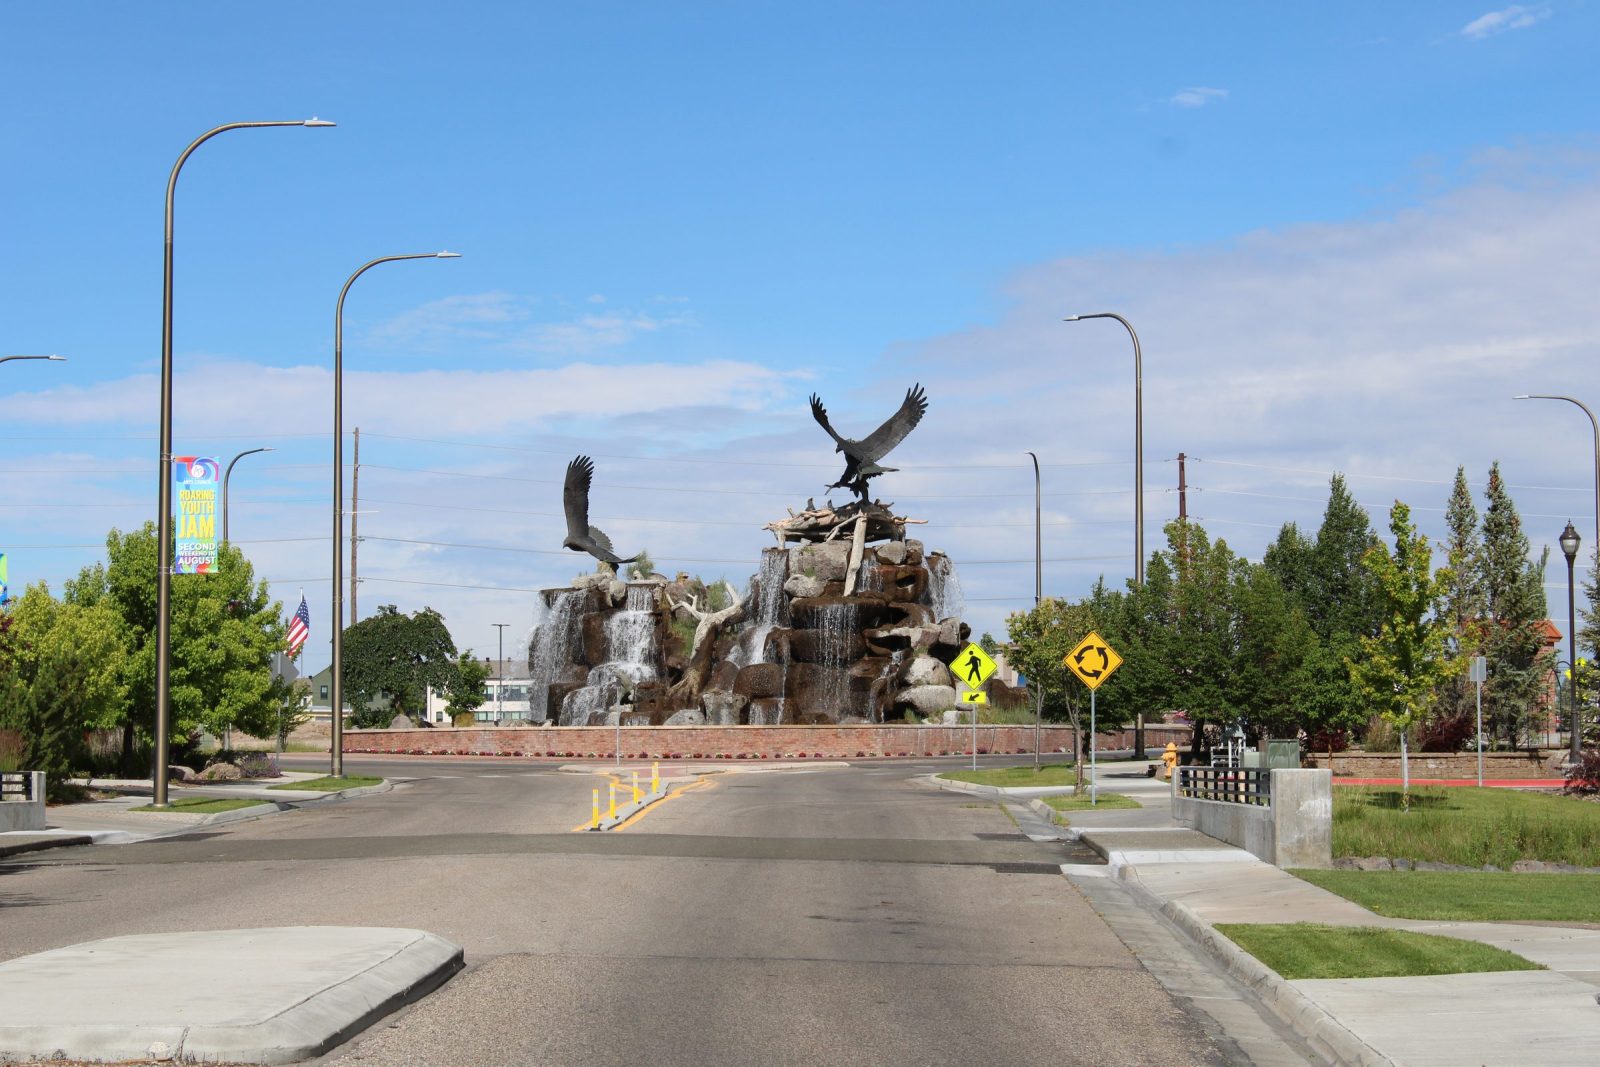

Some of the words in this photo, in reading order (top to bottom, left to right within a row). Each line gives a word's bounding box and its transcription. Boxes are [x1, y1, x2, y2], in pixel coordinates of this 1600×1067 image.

[179, 489, 215, 501] ROARING
[181, 502, 215, 515] YOUTH
[179, 515, 215, 539] JAM
[178, 543, 216, 551] SECOND
[178, 556, 215, 564] AUGUST
